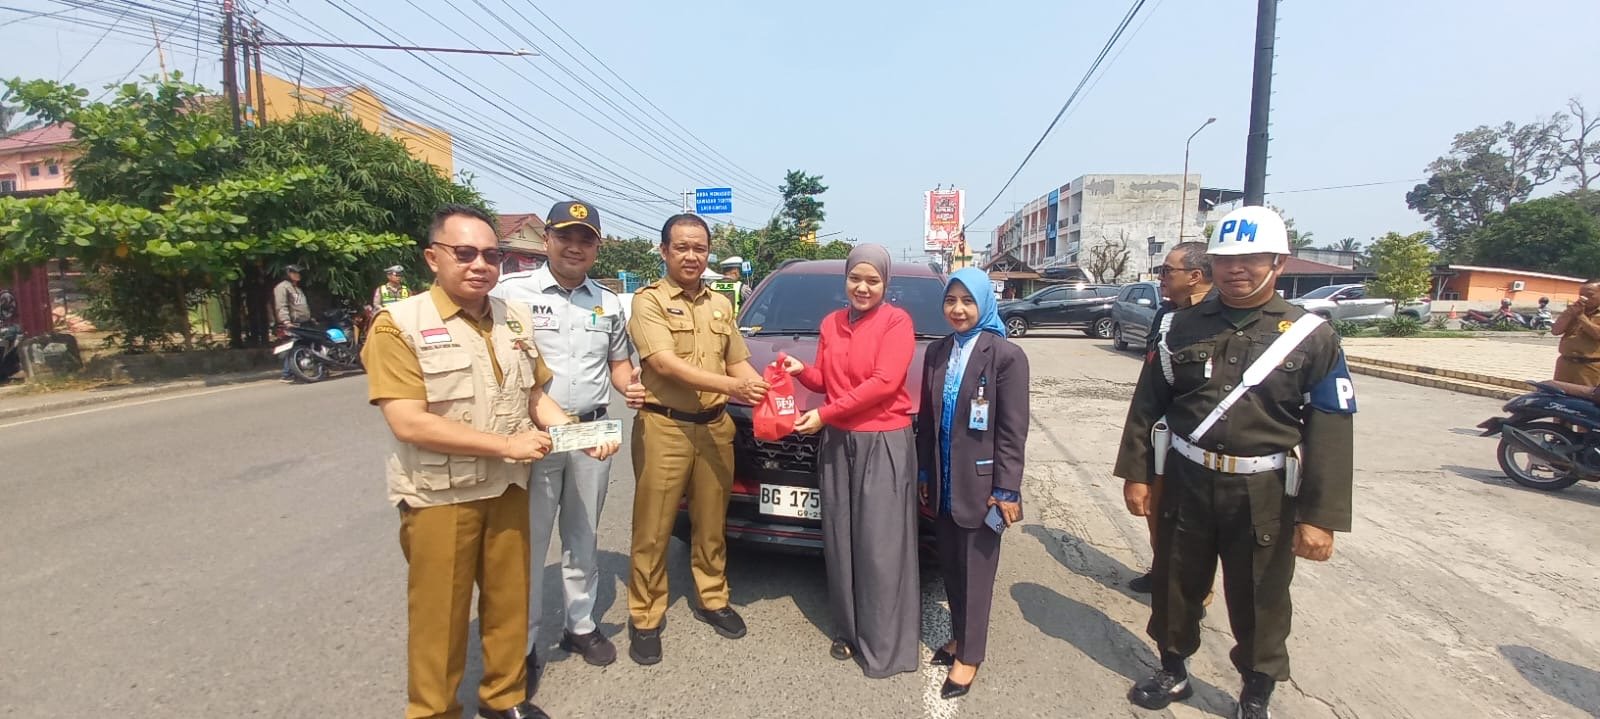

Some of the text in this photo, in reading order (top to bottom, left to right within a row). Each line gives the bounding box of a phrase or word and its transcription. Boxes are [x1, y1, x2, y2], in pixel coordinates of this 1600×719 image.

[1219, 219, 1257, 242] PM
[1336, 377, 1353, 409] P
[761, 487, 820, 508] BG 175
